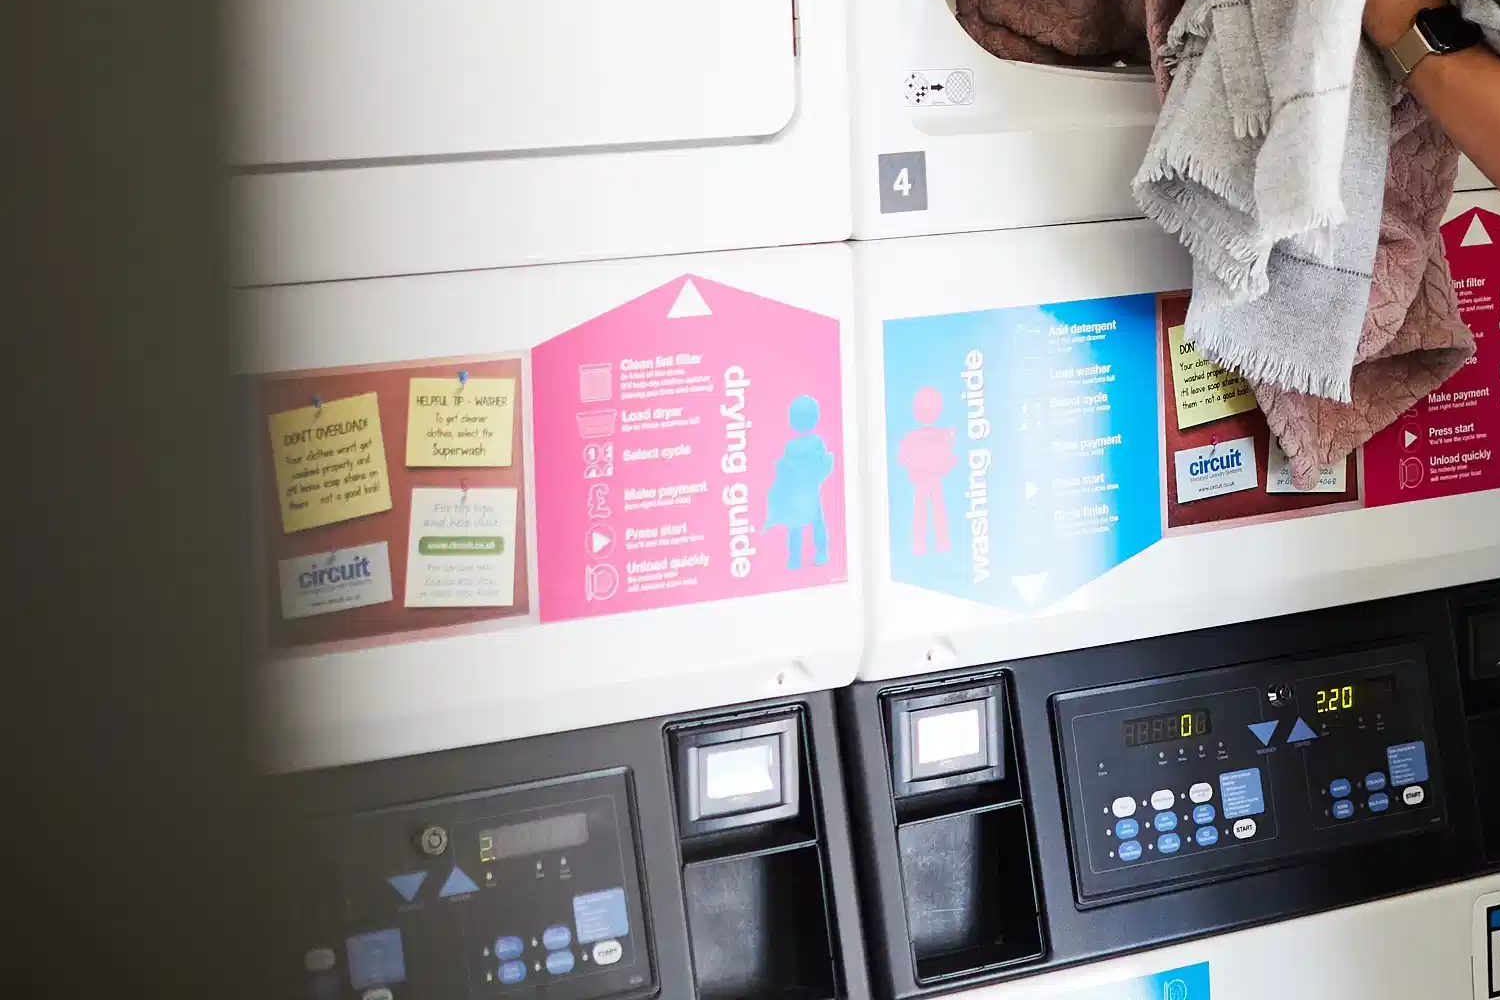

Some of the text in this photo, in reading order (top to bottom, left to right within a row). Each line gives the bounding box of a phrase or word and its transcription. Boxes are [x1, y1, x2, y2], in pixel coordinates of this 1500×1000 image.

[892, 167, 912, 197] 4
[1466, 277, 1486, 288] filter
[1048, 319, 1117, 336] Add detergent
[1076, 363, 1112, 377] washer
[1180, 362, 1193, 371] Your
[1184, 370, 1205, 384] washed
[1190, 385, 1206, 396] leave
[1207, 382, 1221, 392] soap
[1428, 387, 1490, 404] Make payment
[416, 395, 508, 407] HELPFUL TIP WASHER
[1083, 391, 1108, 405] cycle
[1182, 401, 1198, 410] them
[1205, 395, 1215, 404] not
[1222, 390, 1236, 403] good
[1440, 403, 1452, 411] right
[435, 412, 488, 427] To get cleaner
[621, 408, 651, 423] Load
[719, 365, 753, 474] drying
[457, 427, 479, 438] select
[482, 427, 495, 438] the
[1429, 422, 1475, 438] Press start
[359, 438, 372, 453] get
[1080, 433, 1122, 450] payment
[432, 441, 486, 460] Superwash
[661, 444, 692, 460] cycle
[1430, 448, 1492, 466] Unload quickly
[321, 453, 371, 477] properly and
[961, 347, 992, 584] washing guide
[1189, 448, 1242, 476] circuit
[1438, 465, 1456, 473] nobody
[1082, 472, 1105, 485] start
[1459, 472, 1470, 480] your
[320, 487, 361, 505] not good
[658, 480, 708, 500] payment
[1083, 504, 1109, 518] finish
[722, 483, 757, 578] guide
[669, 552, 711, 570] quickly
[298, 555, 372, 589] circuit
[1316, 685, 1353, 713] 2.20
[1180, 713, 1192, 737] 0
[1406, 791, 1421, 800] START
[1236, 824, 1253, 833] START
